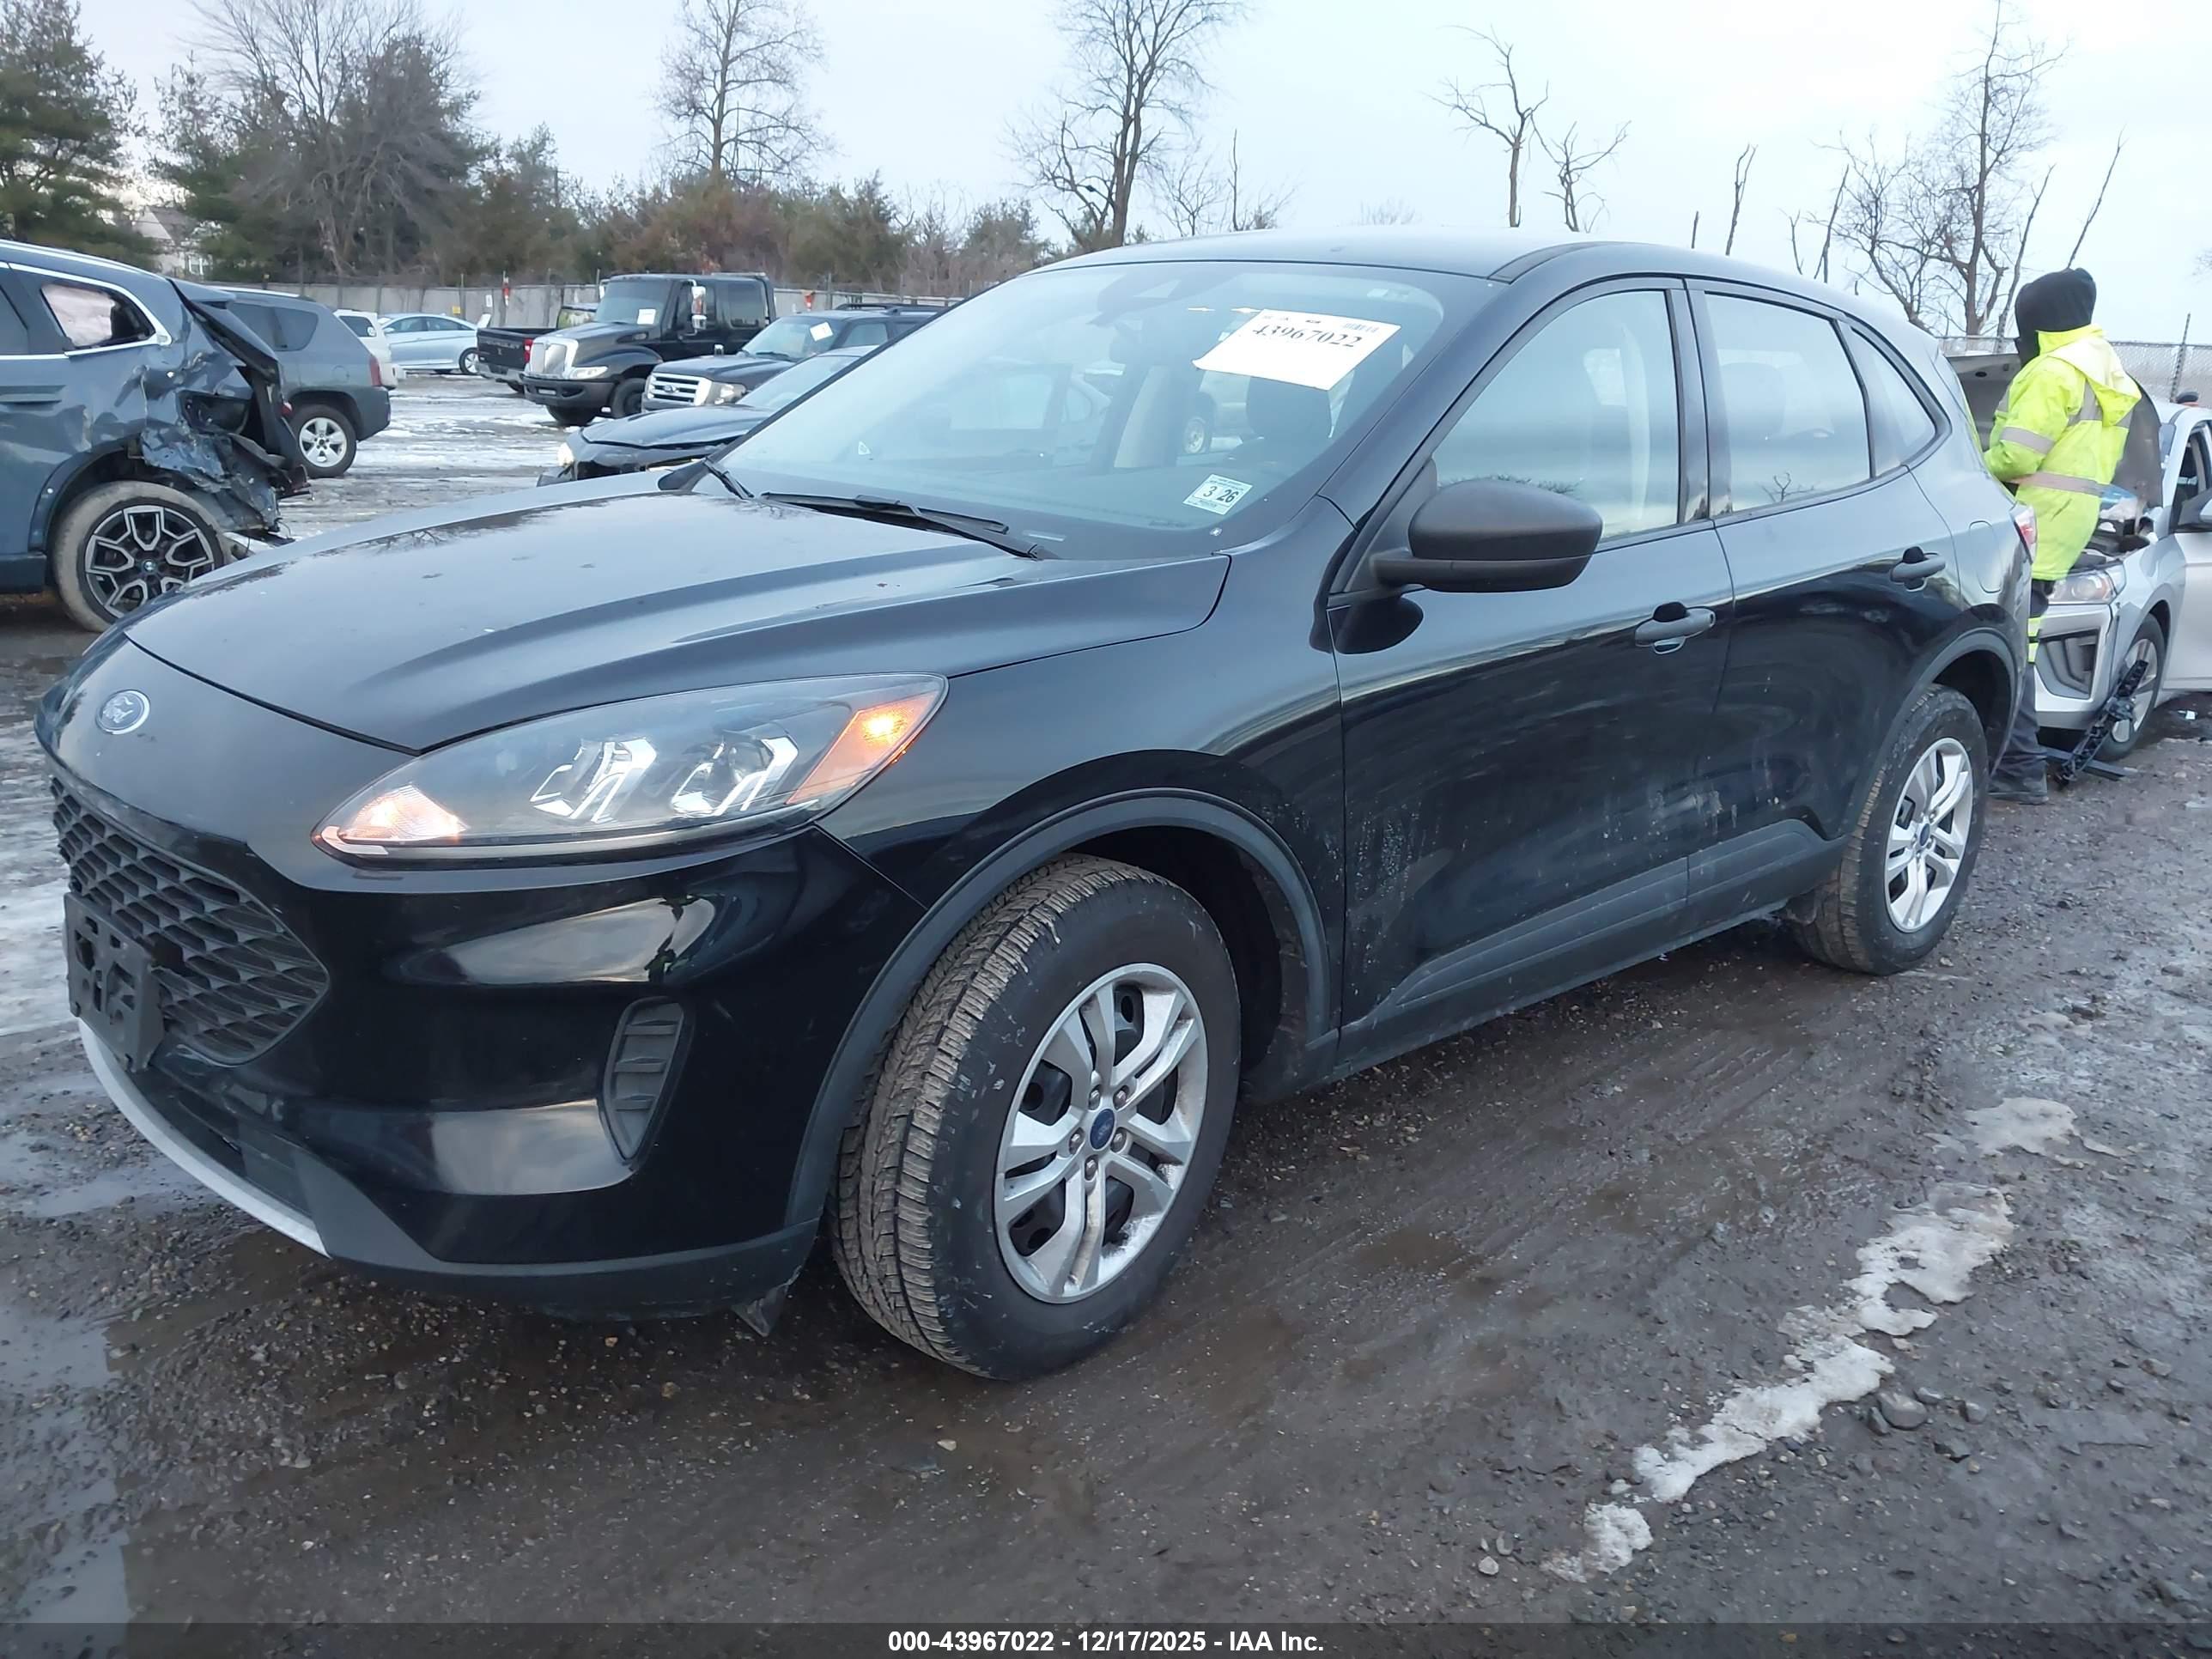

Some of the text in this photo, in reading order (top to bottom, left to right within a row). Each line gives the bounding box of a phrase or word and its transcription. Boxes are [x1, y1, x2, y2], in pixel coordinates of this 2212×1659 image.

[1253, 324, 1363, 348] 43967022
[1203, 485, 1218, 497] 3
[1216, 489, 1239, 503] 26
